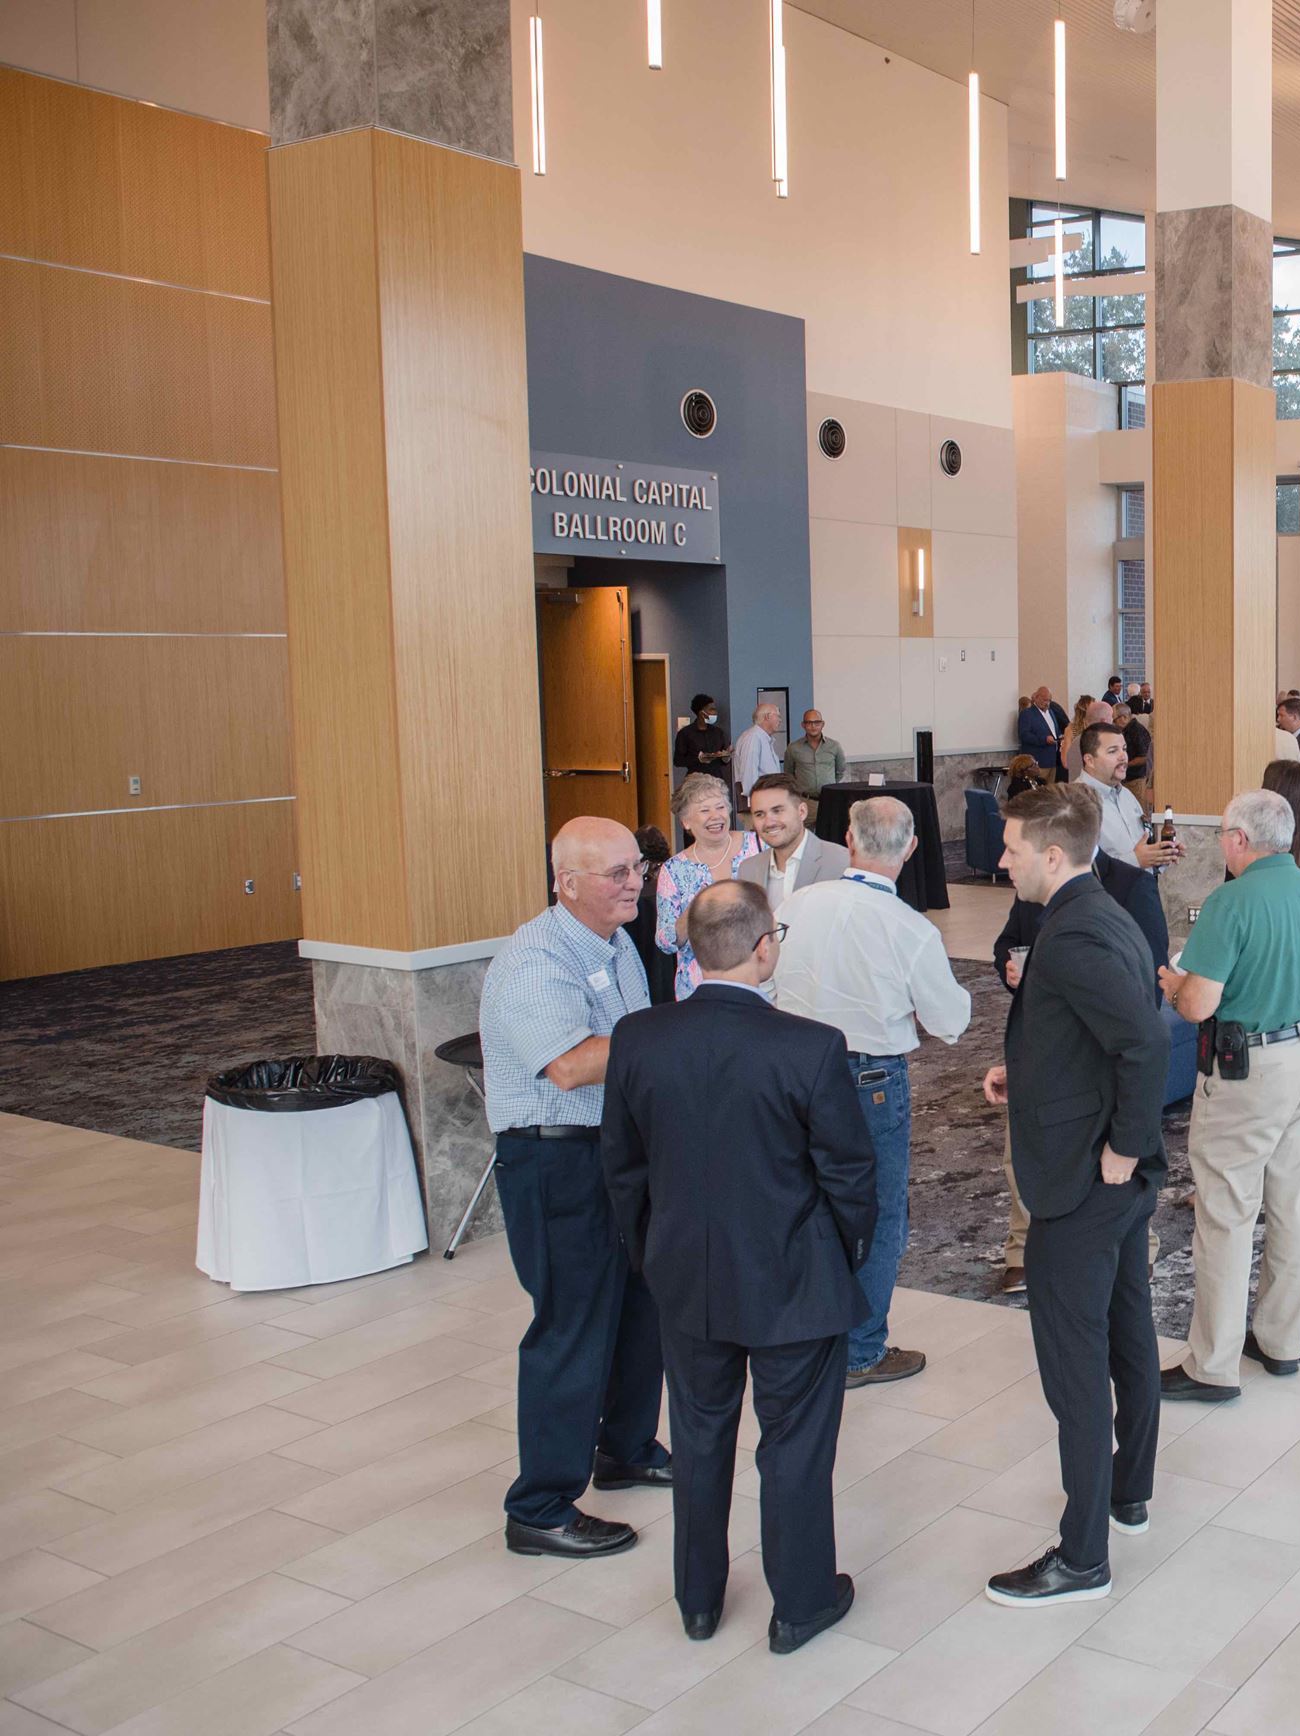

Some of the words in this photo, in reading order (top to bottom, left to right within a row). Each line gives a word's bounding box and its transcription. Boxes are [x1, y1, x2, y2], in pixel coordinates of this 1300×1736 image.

[634, 478, 712, 510] CAPITAL
[554, 511, 667, 546] BALLROOM
[673, 522, 687, 547] C
